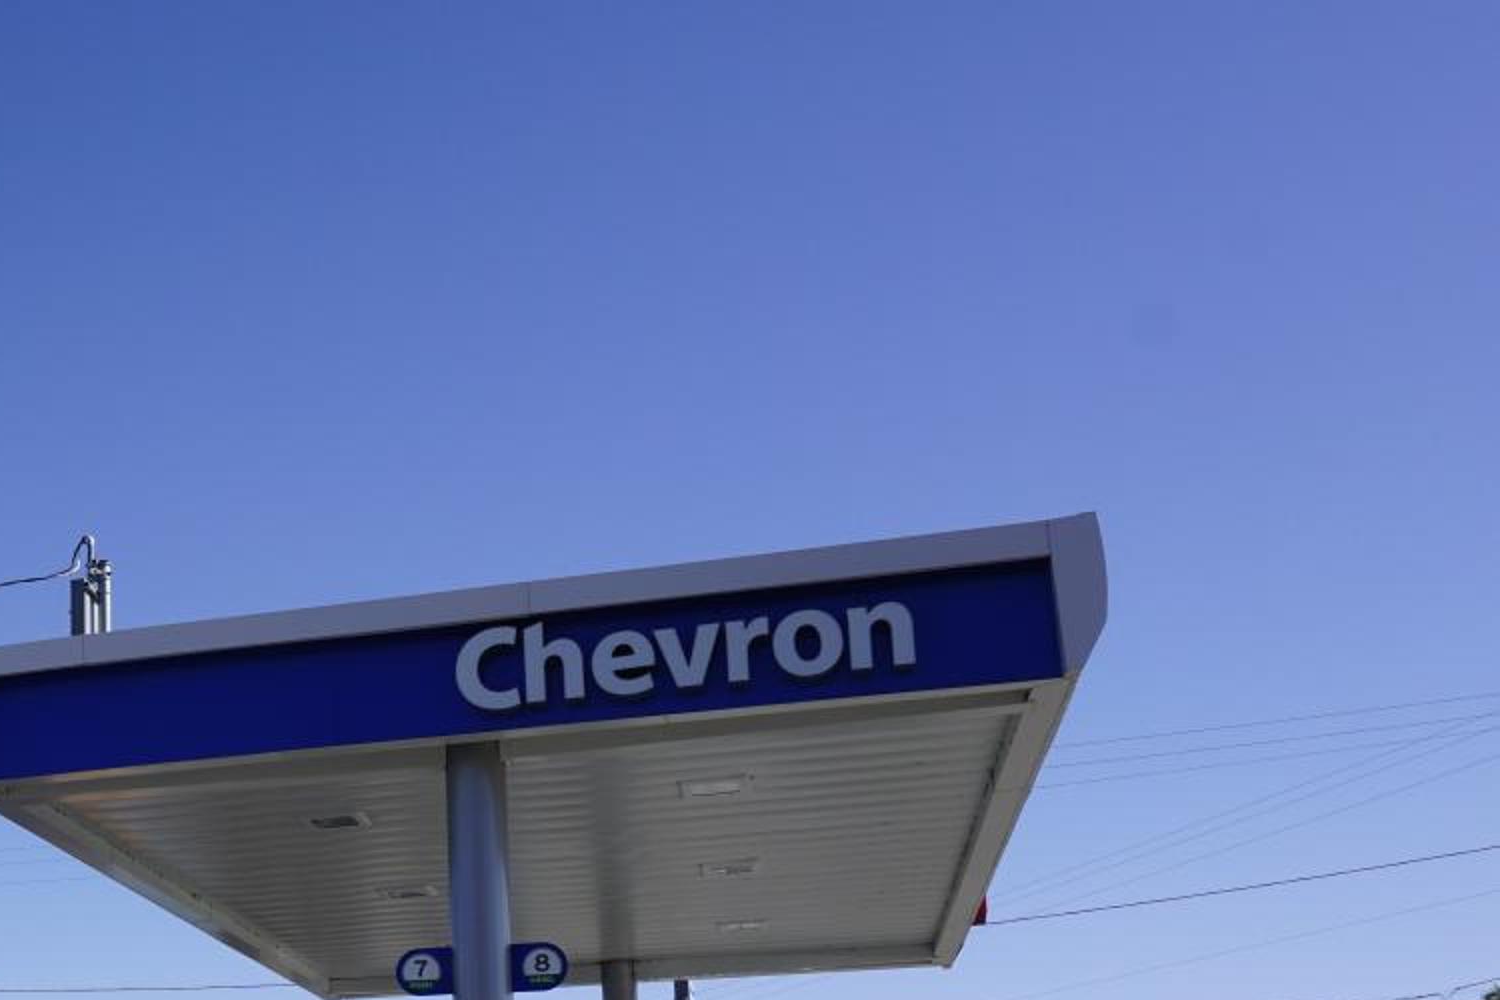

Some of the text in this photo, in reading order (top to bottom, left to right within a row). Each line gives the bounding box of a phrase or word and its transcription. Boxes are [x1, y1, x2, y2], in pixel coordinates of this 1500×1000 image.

[455, 600, 917, 711] Chevron
[414, 959, 427, 977] 7
[534, 953, 550, 972] 8
